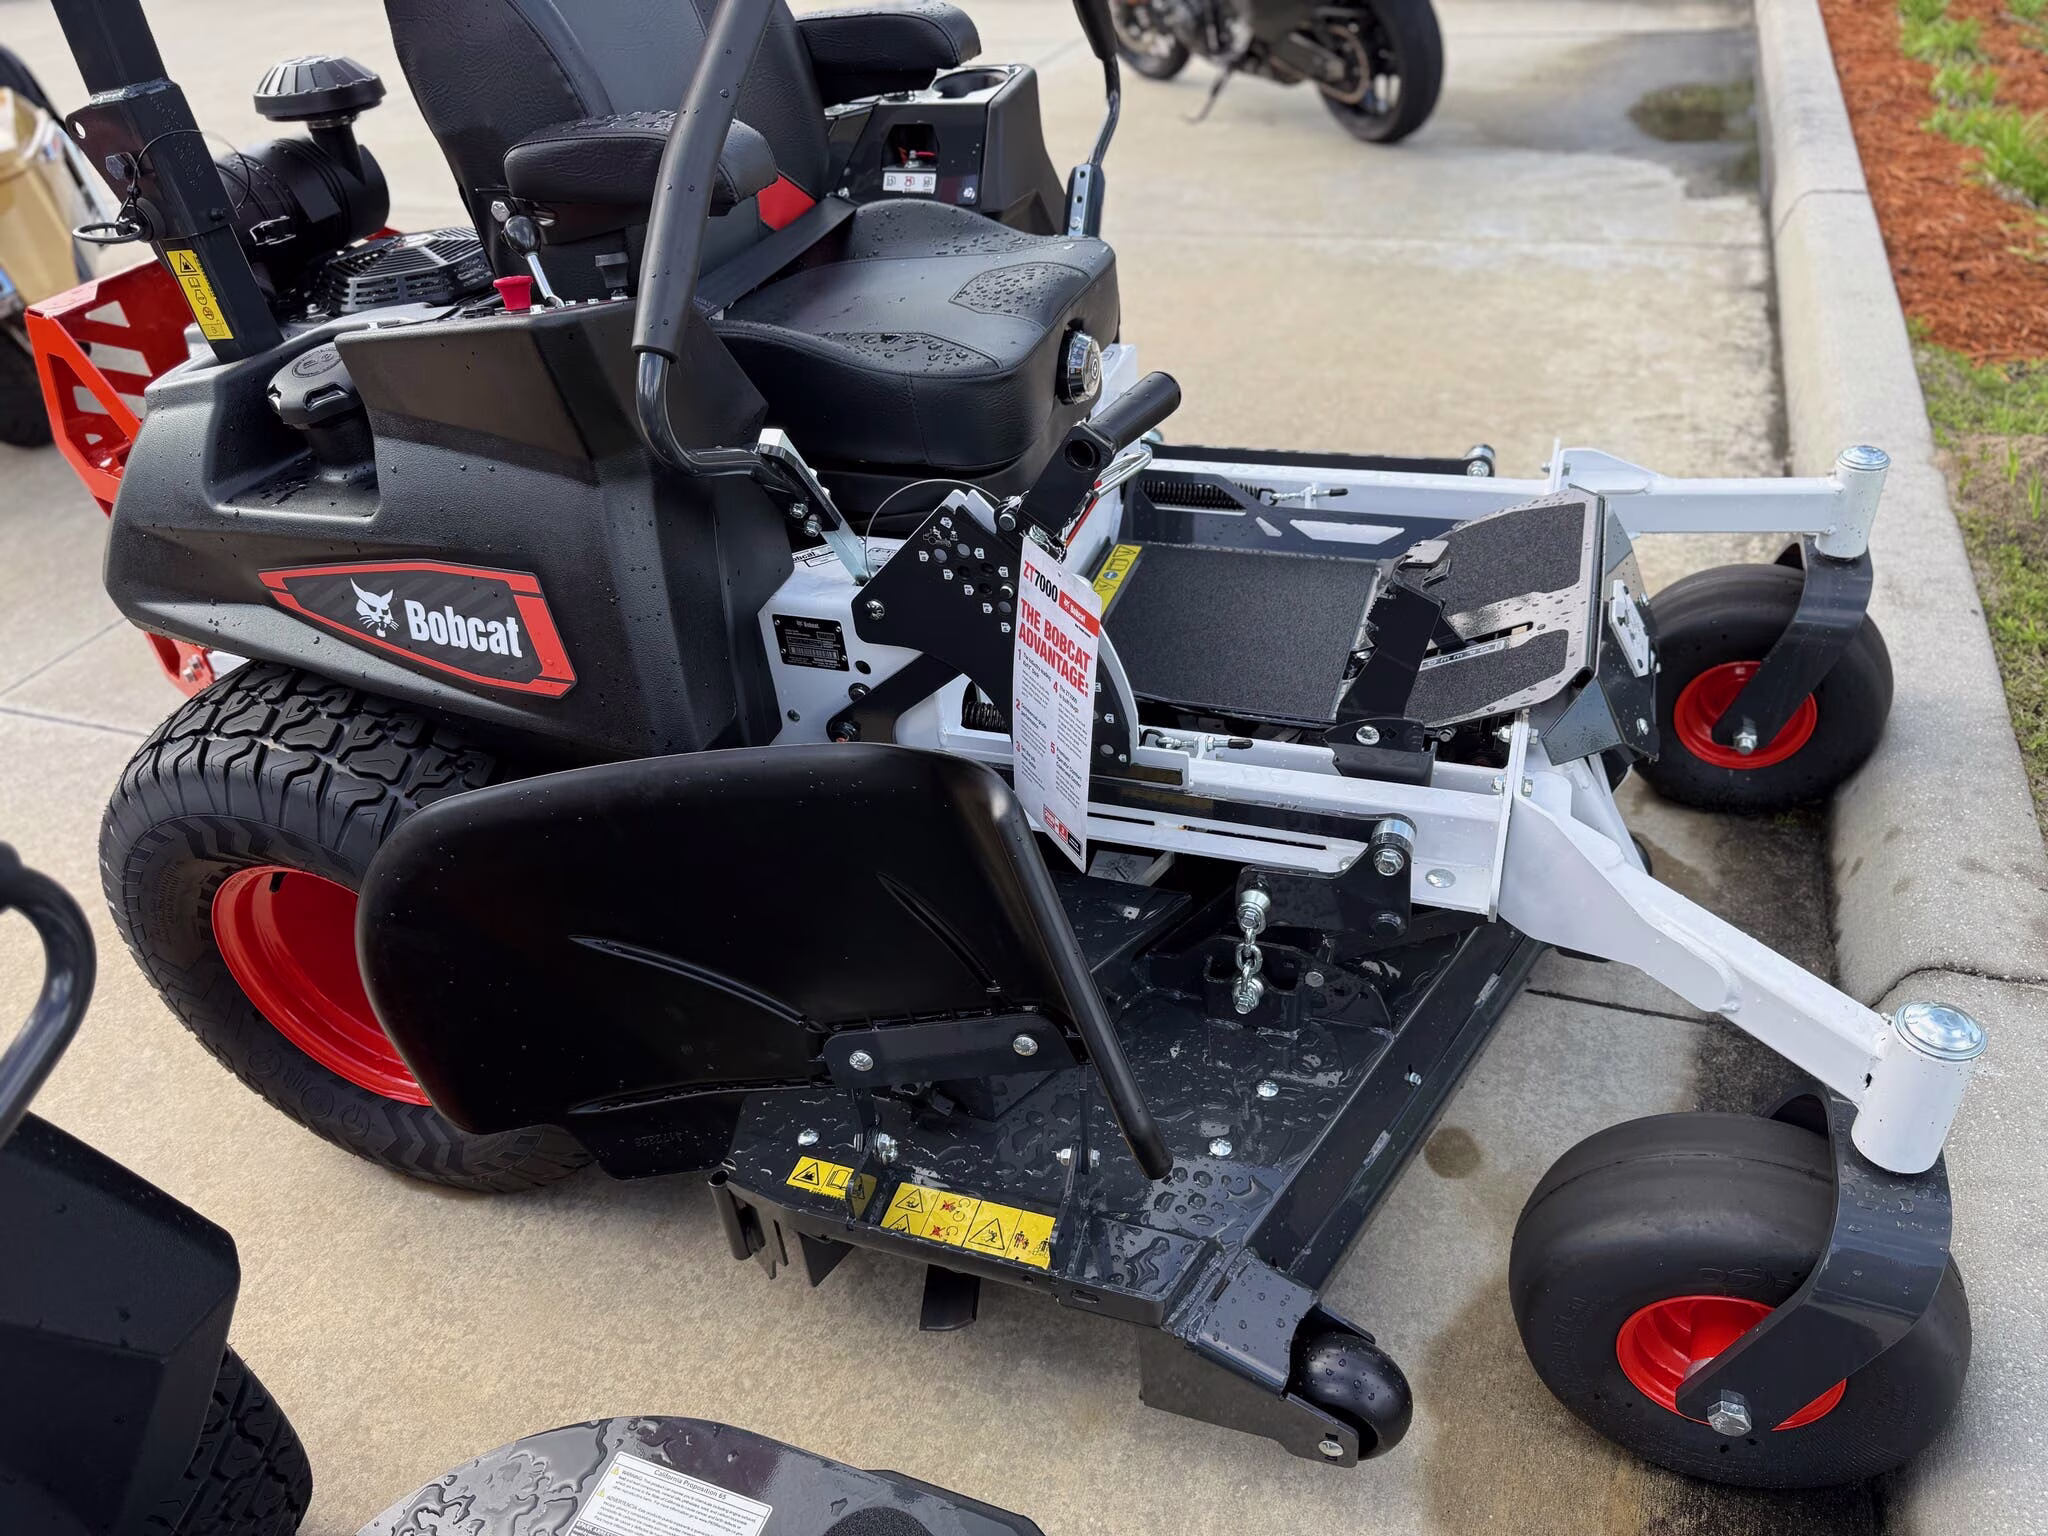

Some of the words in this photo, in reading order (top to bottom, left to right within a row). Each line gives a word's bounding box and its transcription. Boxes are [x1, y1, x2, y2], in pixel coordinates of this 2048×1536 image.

[1024, 560, 1058, 603] ZT7000
[403, 598, 523, 659] Bobcat
[1021, 597, 1041, 632] THE
[1044, 619, 1091, 673] BOBCAT
[1018, 622, 1088, 698] ADVANTAGE:
[1016, 698, 1020, 711] 2
[1053, 681, 1058, 693] 4
[1051, 741, 1055, 754] 5
[654, 1469, 683, 1485] California
[683, 1479, 718, 1498] Proposition
[718, 1491, 727, 1501] 65
